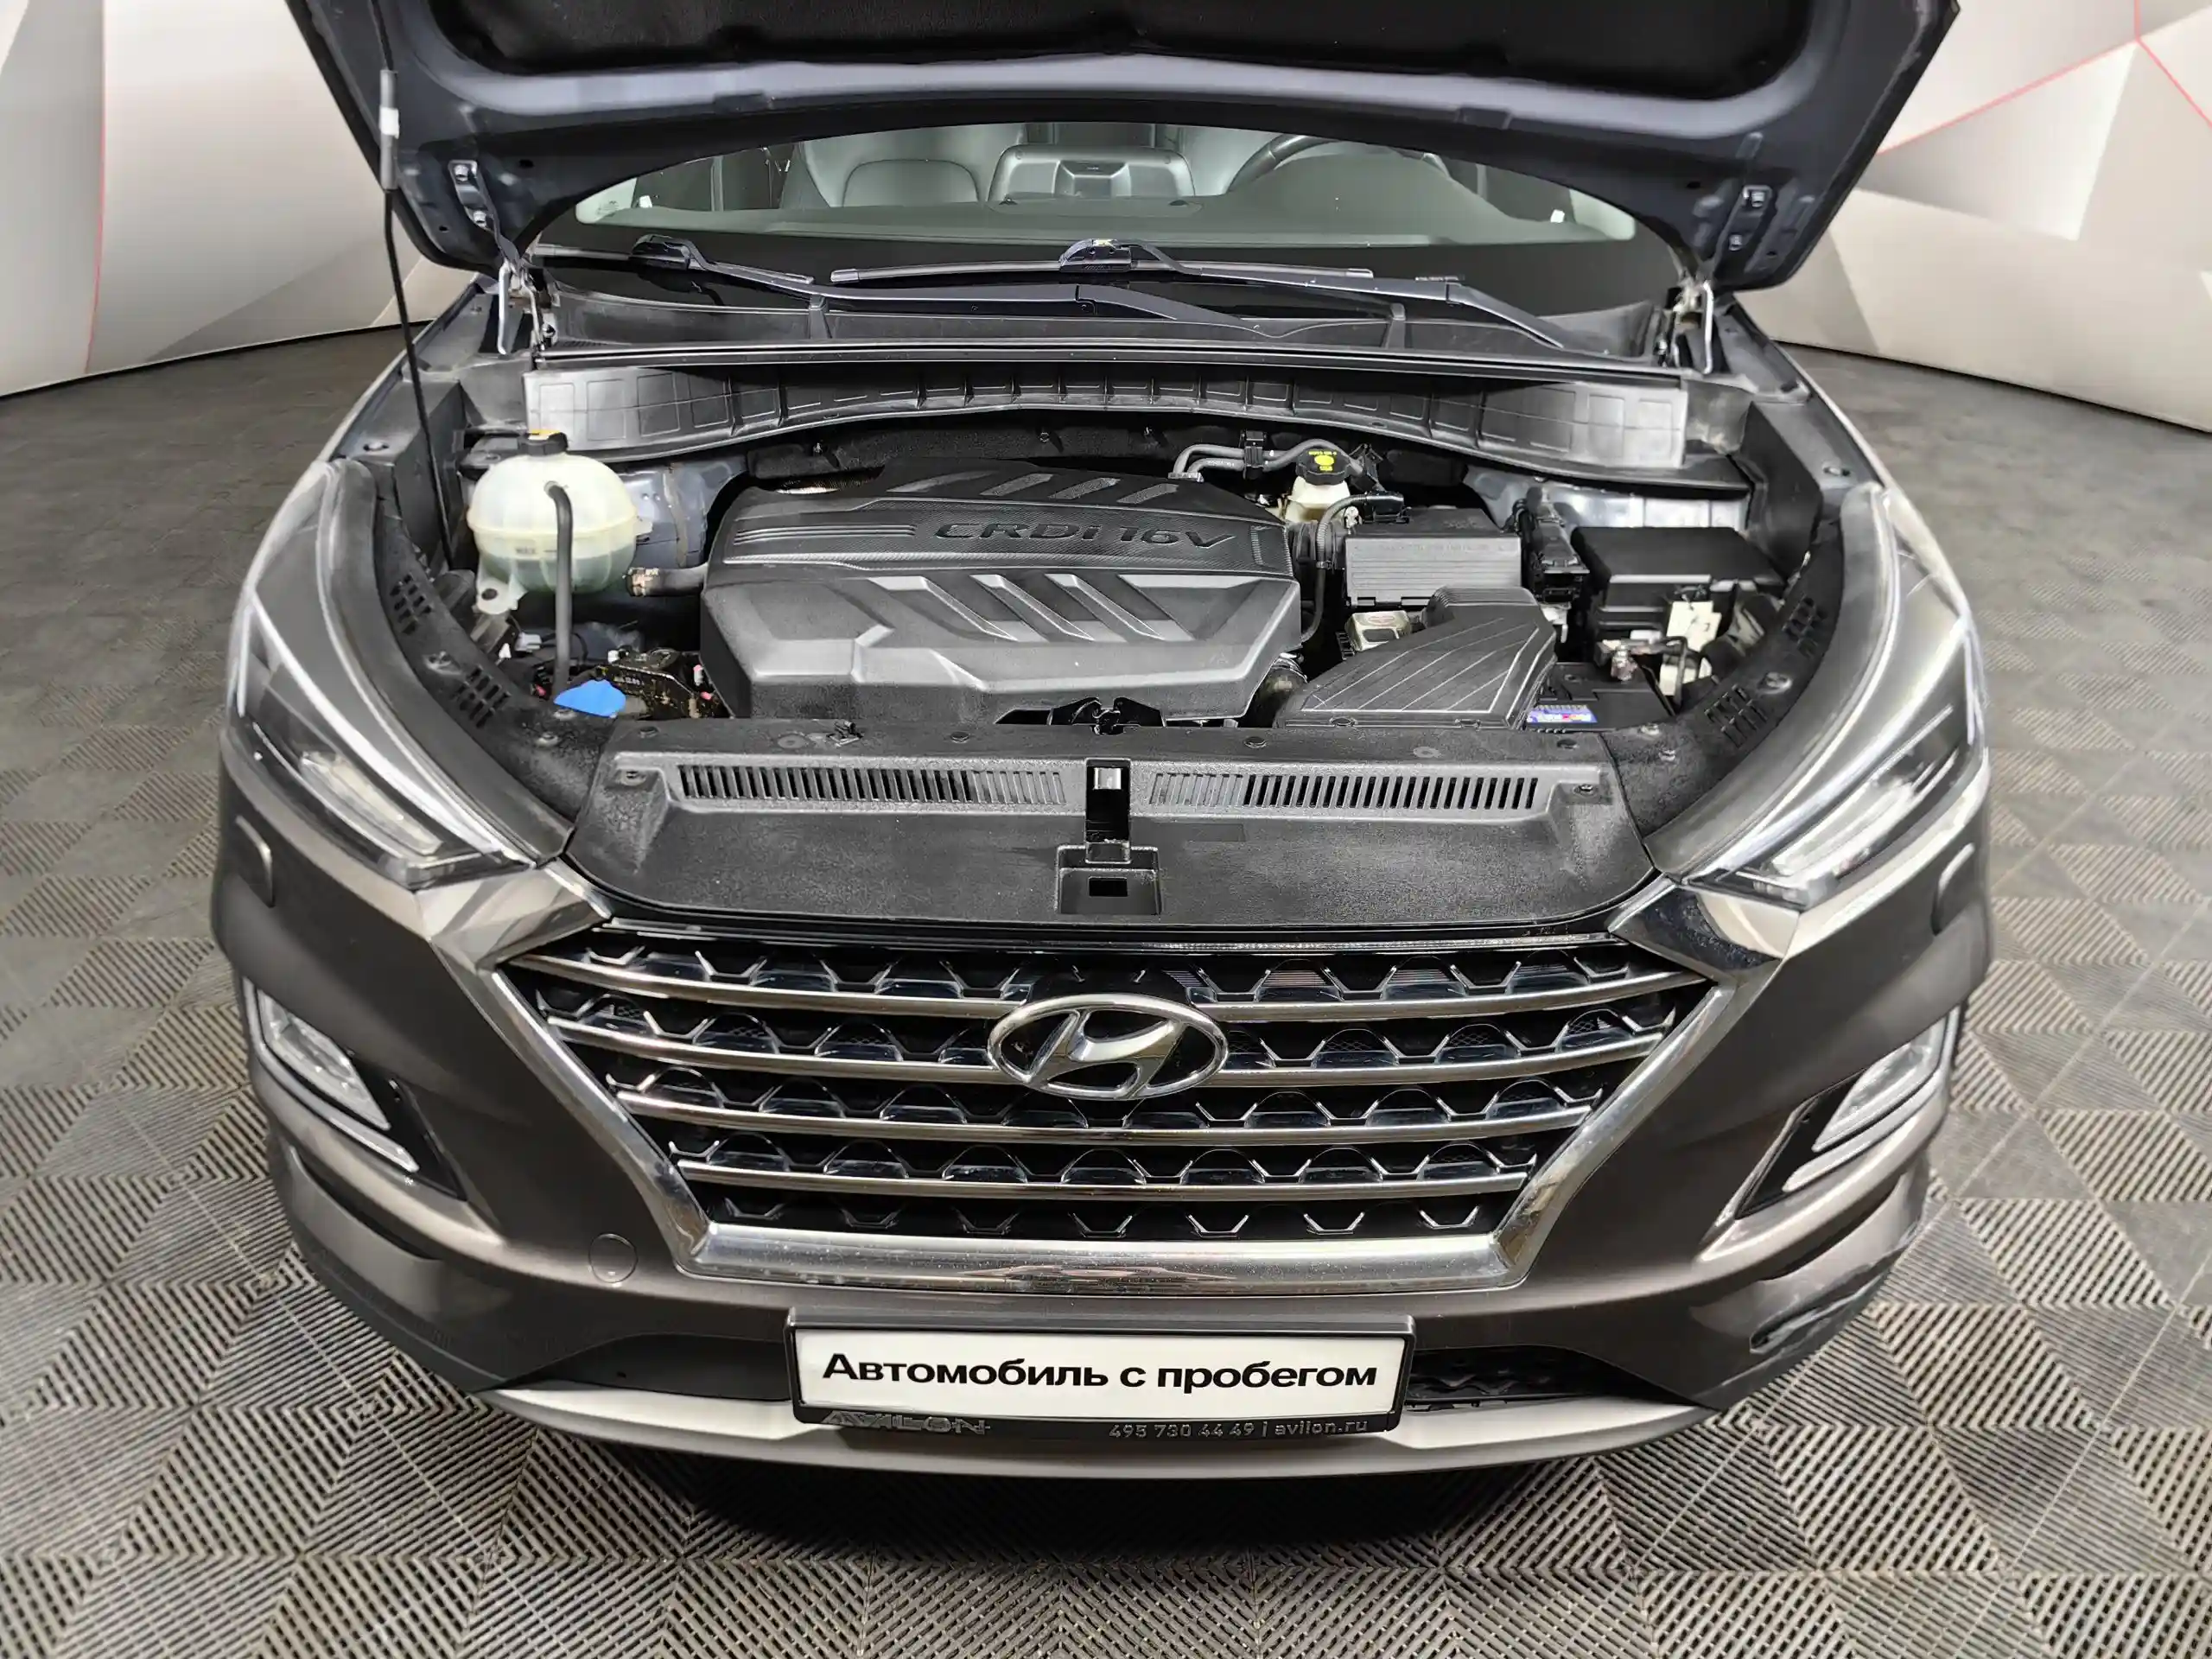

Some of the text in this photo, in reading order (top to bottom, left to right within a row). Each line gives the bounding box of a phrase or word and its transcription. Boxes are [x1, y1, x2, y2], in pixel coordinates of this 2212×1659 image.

[1119, 525, 1237, 550] 16V
[823, 1352, 1377, 1395] Автомобиль с пробегом
[1109, 1423, 1147, 1438] 495
[1154, 1423, 1192, 1437] 730
[1198, 1423, 1224, 1437] 44
[1230, 1422, 1255, 1437] 49
[1274, 1420, 1368, 1436] avilon.ru
